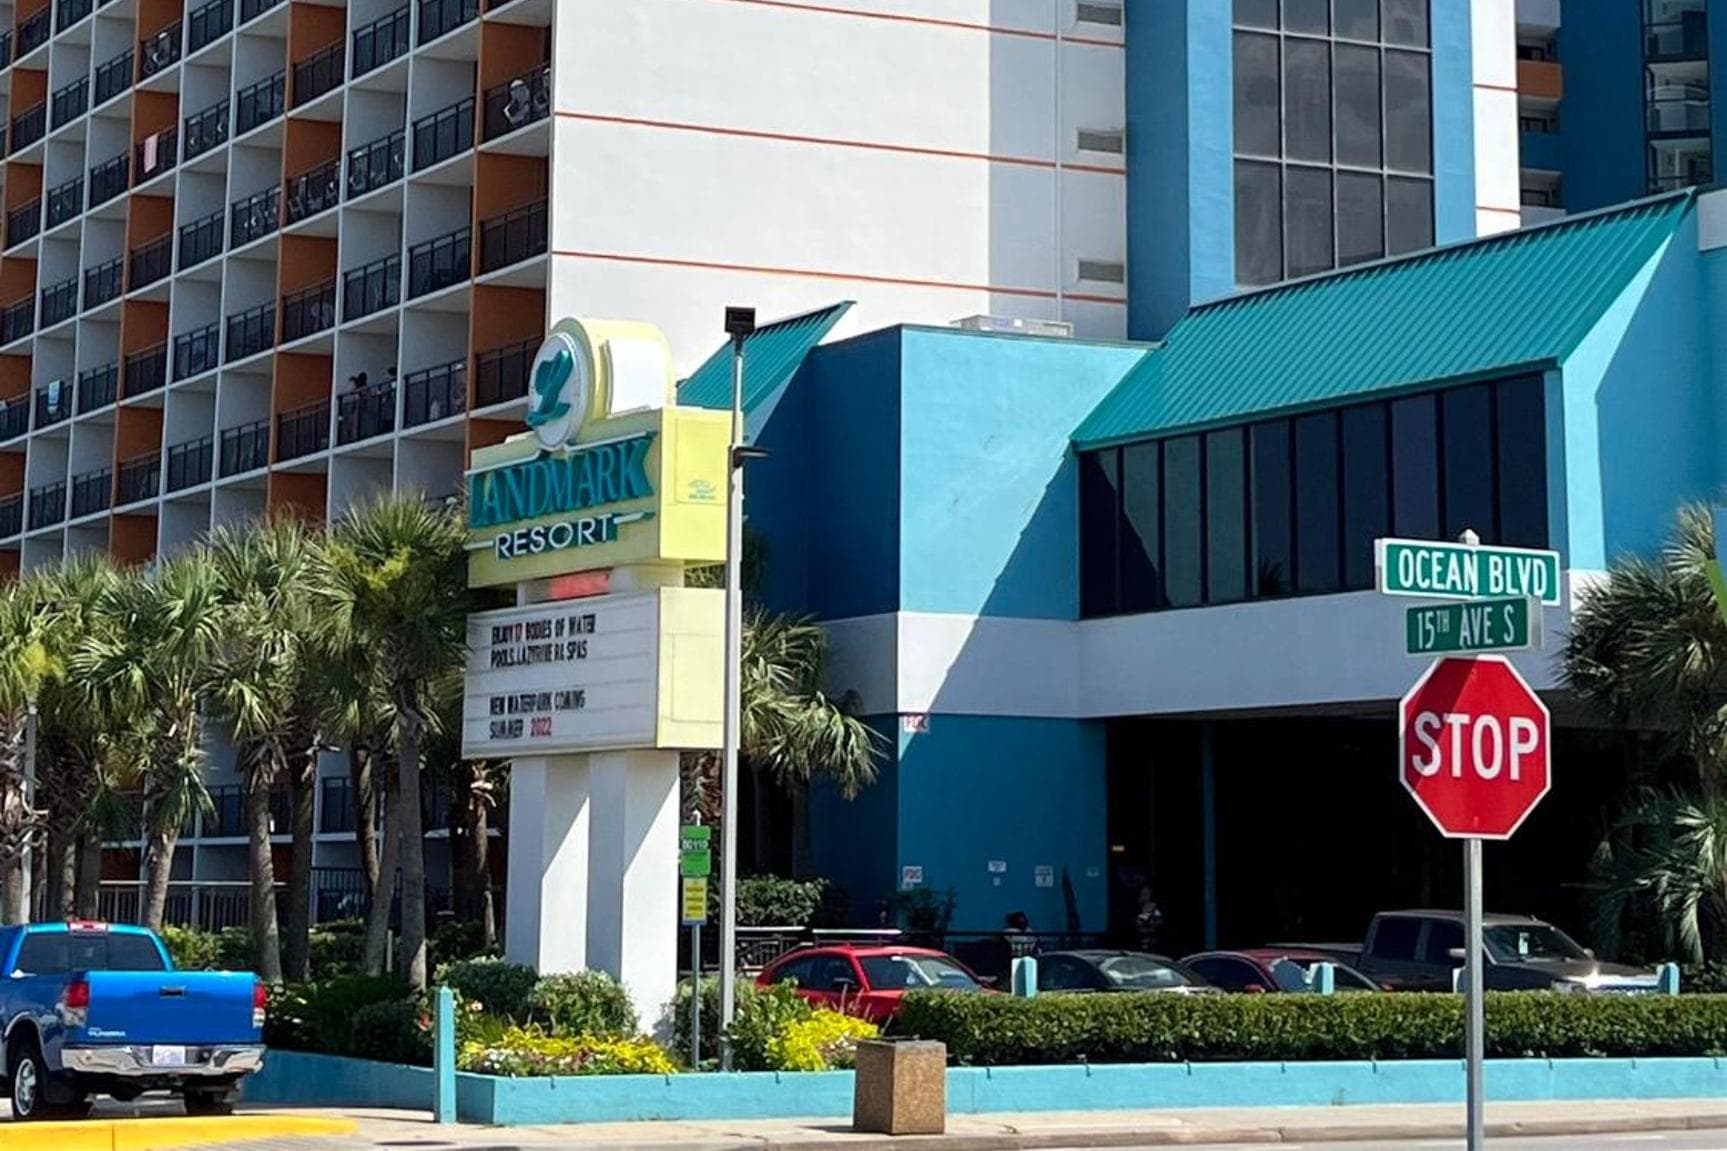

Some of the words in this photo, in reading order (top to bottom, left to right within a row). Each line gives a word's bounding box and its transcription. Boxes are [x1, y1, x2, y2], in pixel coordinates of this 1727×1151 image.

[468, 439, 653, 528] LANDMARK
[495, 514, 613, 559] RESORT
[1398, 548, 1478, 595] OCEAN
[1489, 556, 1548, 596] BLVD
[525, 618, 552, 640] BODIES
[555, 618, 565, 637] OF
[568, 613, 596, 636] WATER
[1416, 606, 1450, 649] 15TH
[1459, 603, 1493, 648] AVE
[1503, 605, 1515, 644] S
[566, 640, 588, 661] SPAS
[490, 695, 506, 716] NEW
[507, 693, 553, 715] WATERPARK
[553, 689, 585, 711] COMING
[489, 718, 524, 740] SUMMER
[530, 716, 552, 738] 2022
[1411, 711, 1540, 781] STOP
